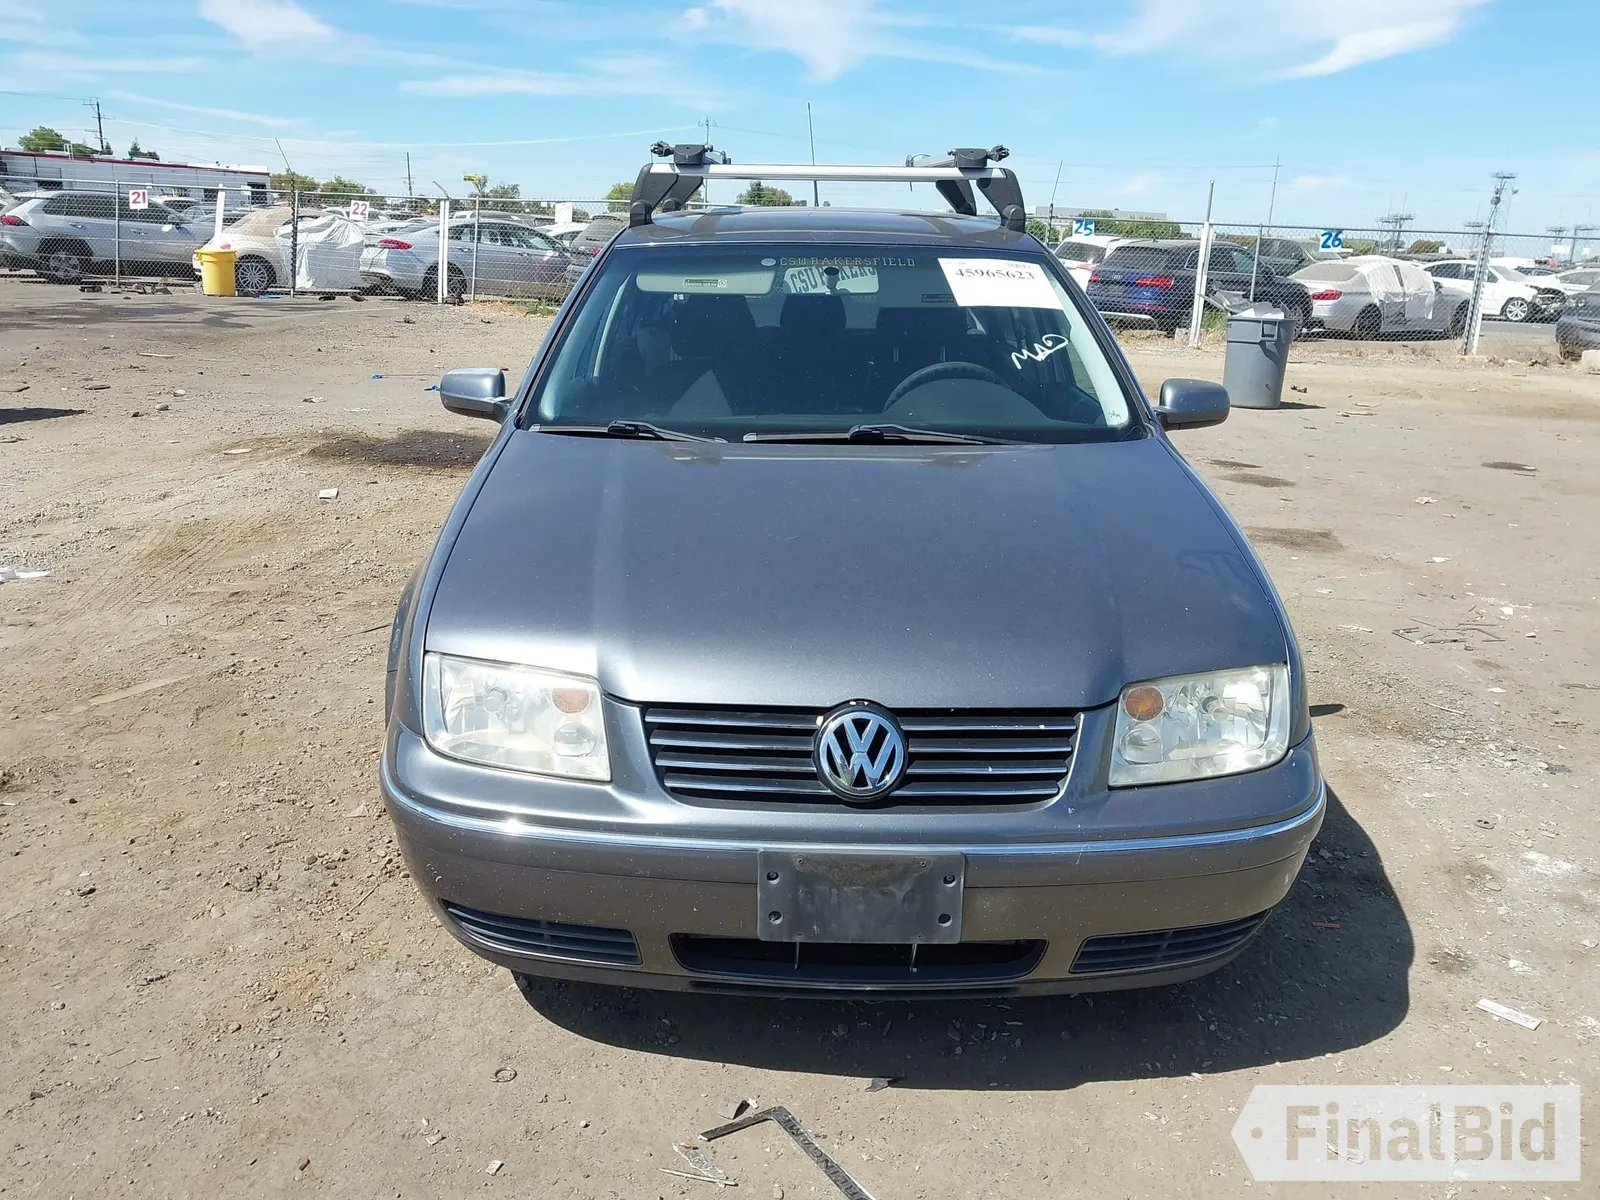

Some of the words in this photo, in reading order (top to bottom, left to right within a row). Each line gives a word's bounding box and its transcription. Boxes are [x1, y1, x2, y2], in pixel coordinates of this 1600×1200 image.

[131, 191, 147, 204] 21
[352, 202, 368, 216] 22
[1074, 219, 1094, 236] 25
[1321, 229, 1343, 248] 26
[779, 257, 807, 266] CSU
[810, 257, 916, 267] BAKERSFIELD
[955, 268, 1035, 280] 45965623
[820, 712, 903, 795] VW
